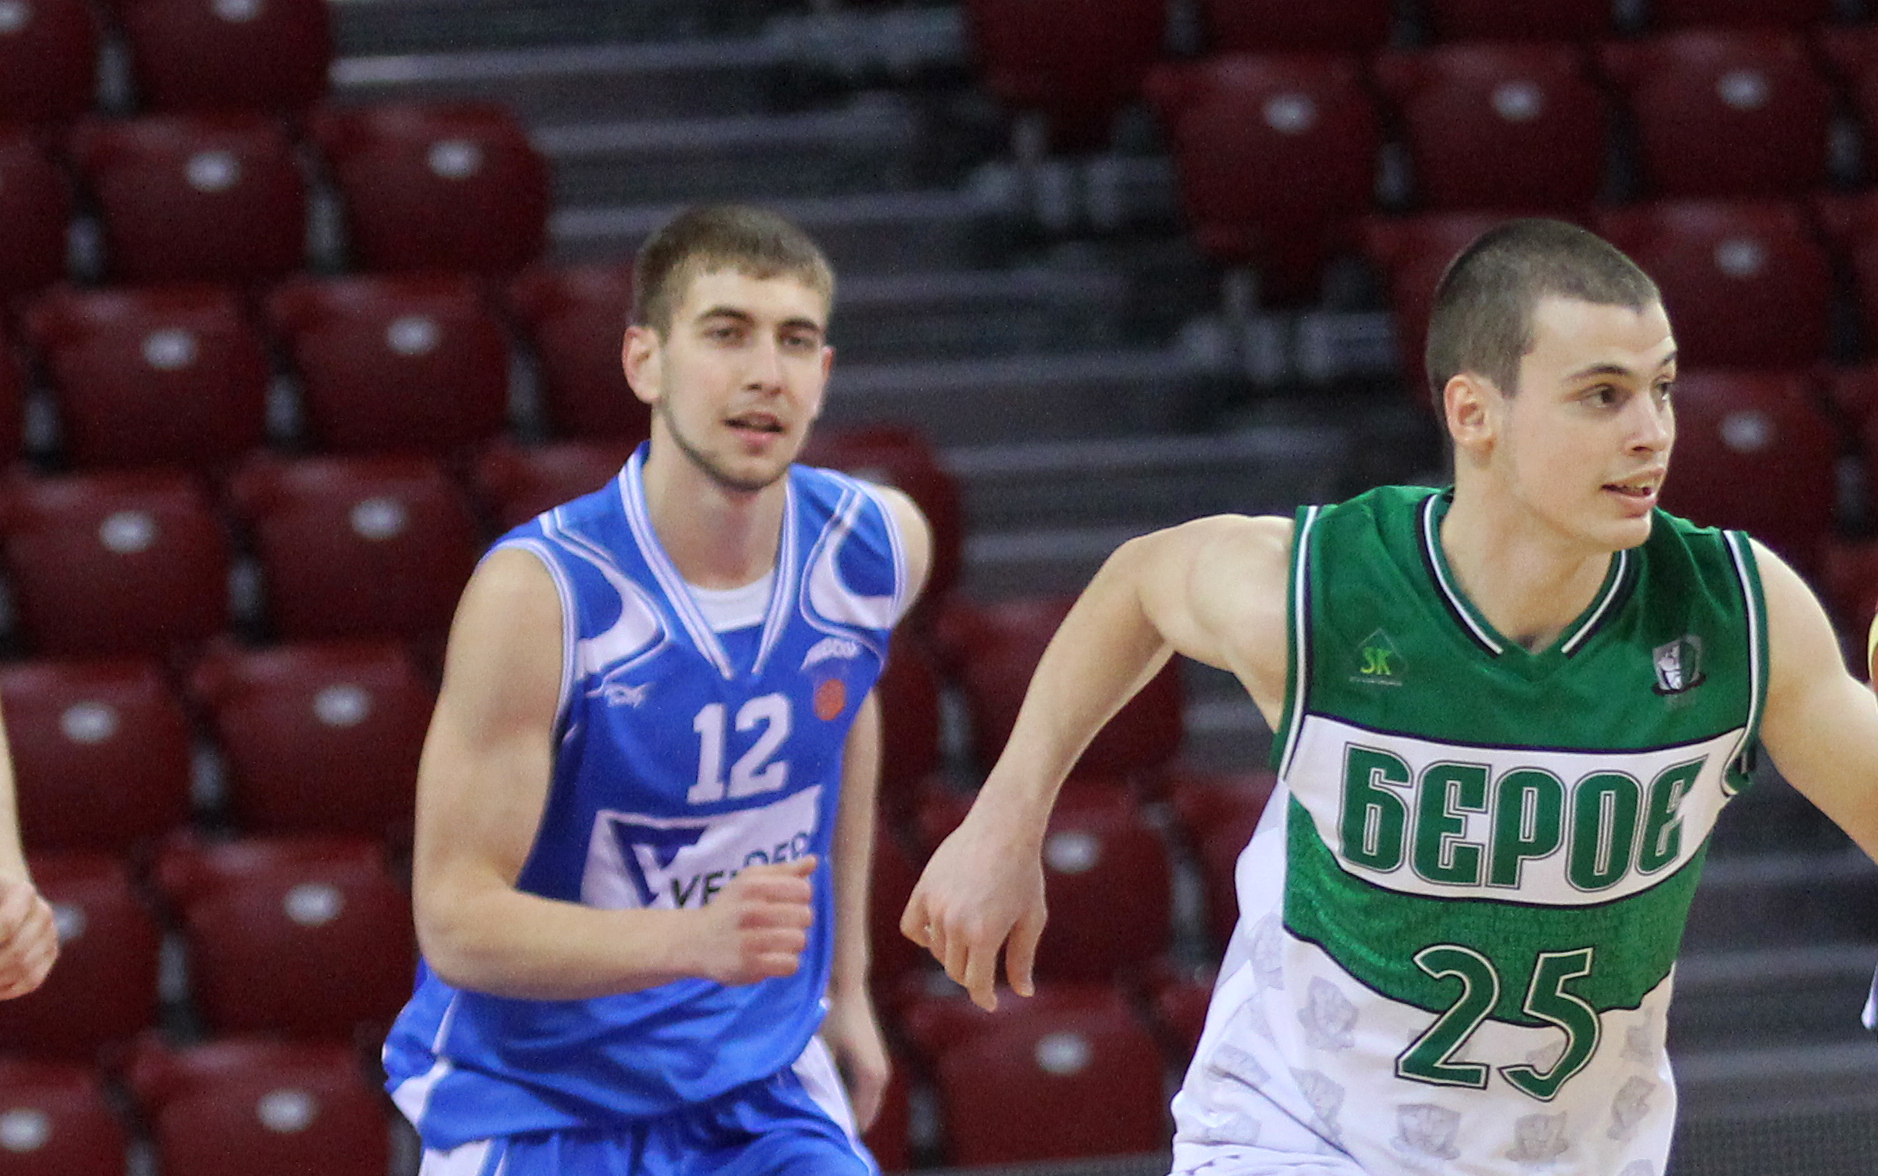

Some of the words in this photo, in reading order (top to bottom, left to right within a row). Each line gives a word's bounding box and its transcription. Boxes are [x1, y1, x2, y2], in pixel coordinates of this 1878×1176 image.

[686, 692, 792, 804] 12
[1338, 740, 1710, 894] БЕРОЕ
[1395, 944, 1603, 1102] 25
